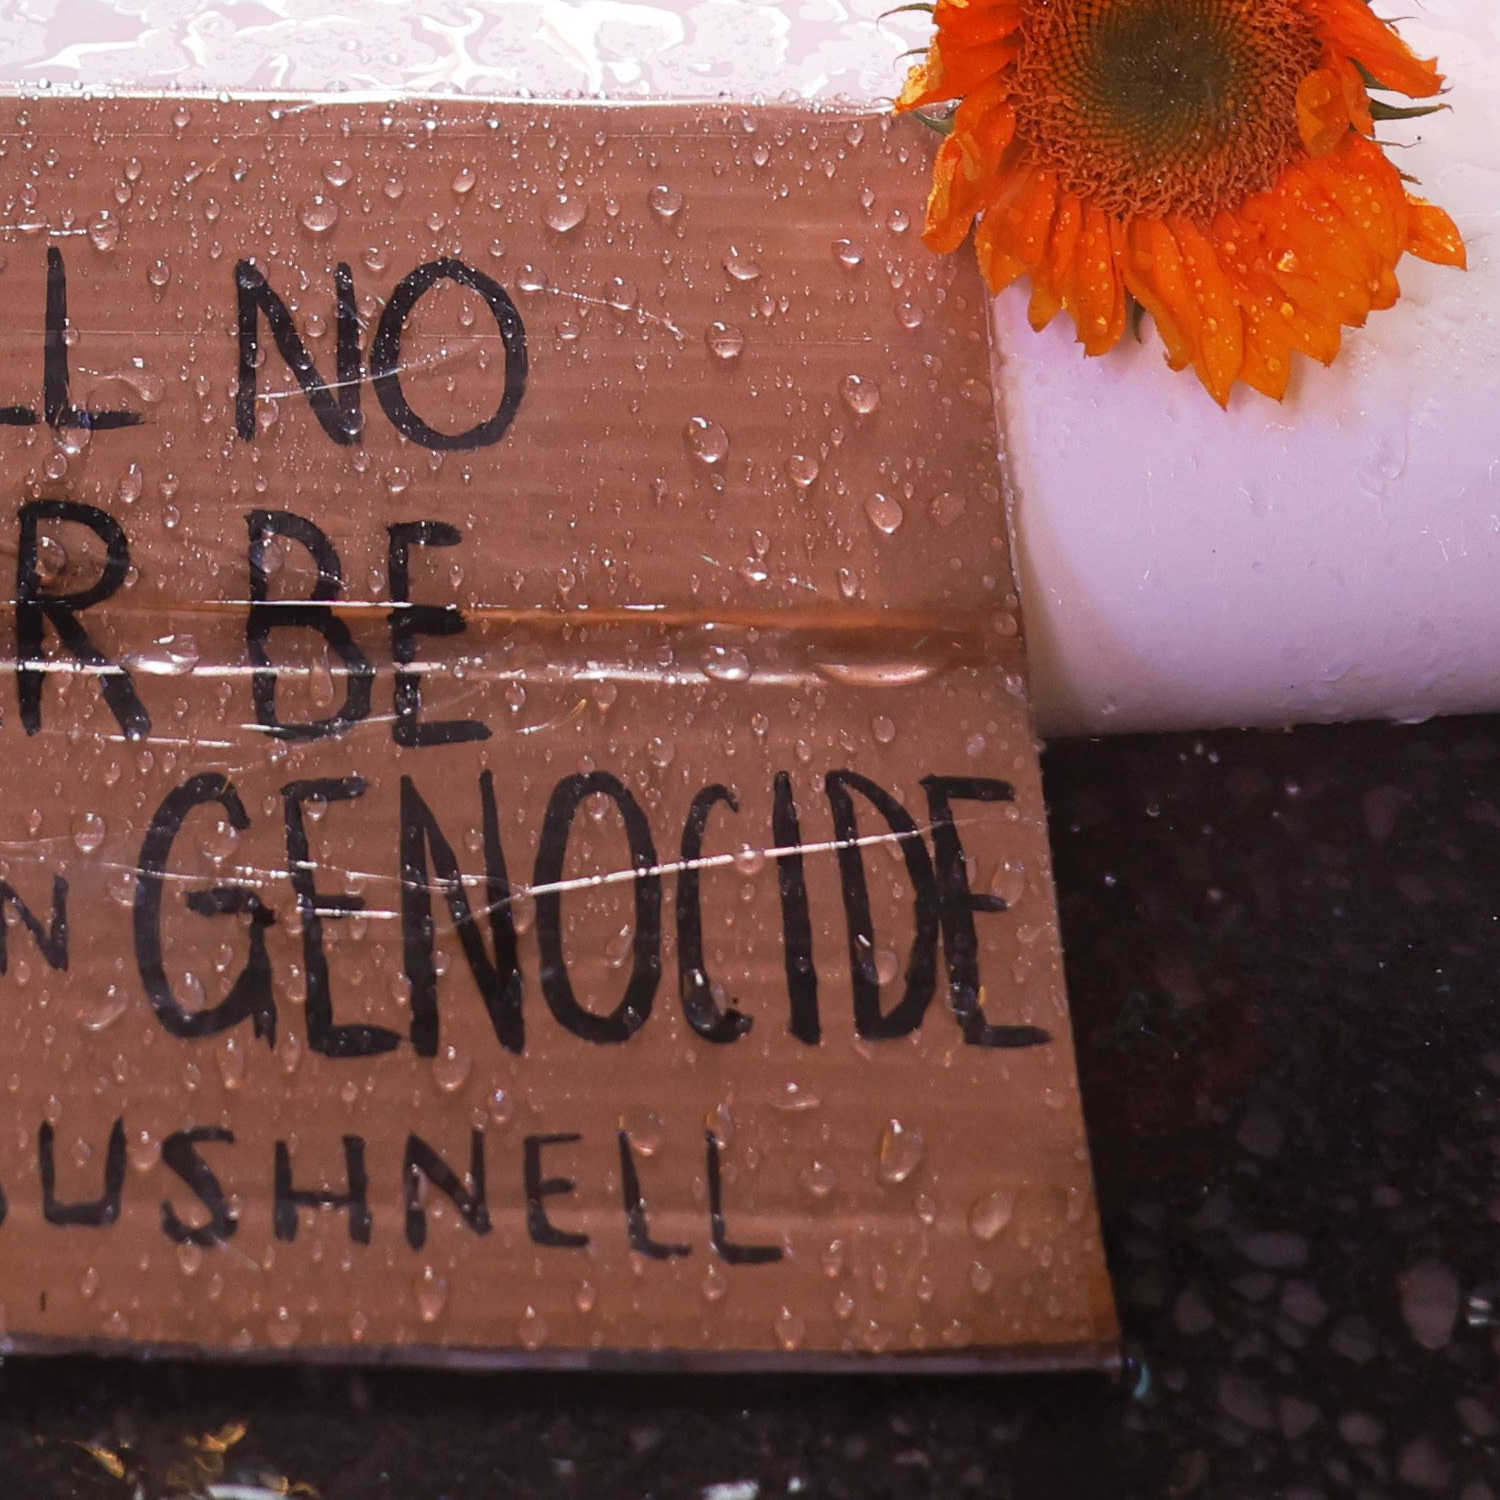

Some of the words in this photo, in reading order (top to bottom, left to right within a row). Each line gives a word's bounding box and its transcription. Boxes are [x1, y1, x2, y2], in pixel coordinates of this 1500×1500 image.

[236, 258, 527, 450] NO
[245, 510, 491, 748] BE
[134, 768, 1051, 1056] GENOCIDE
